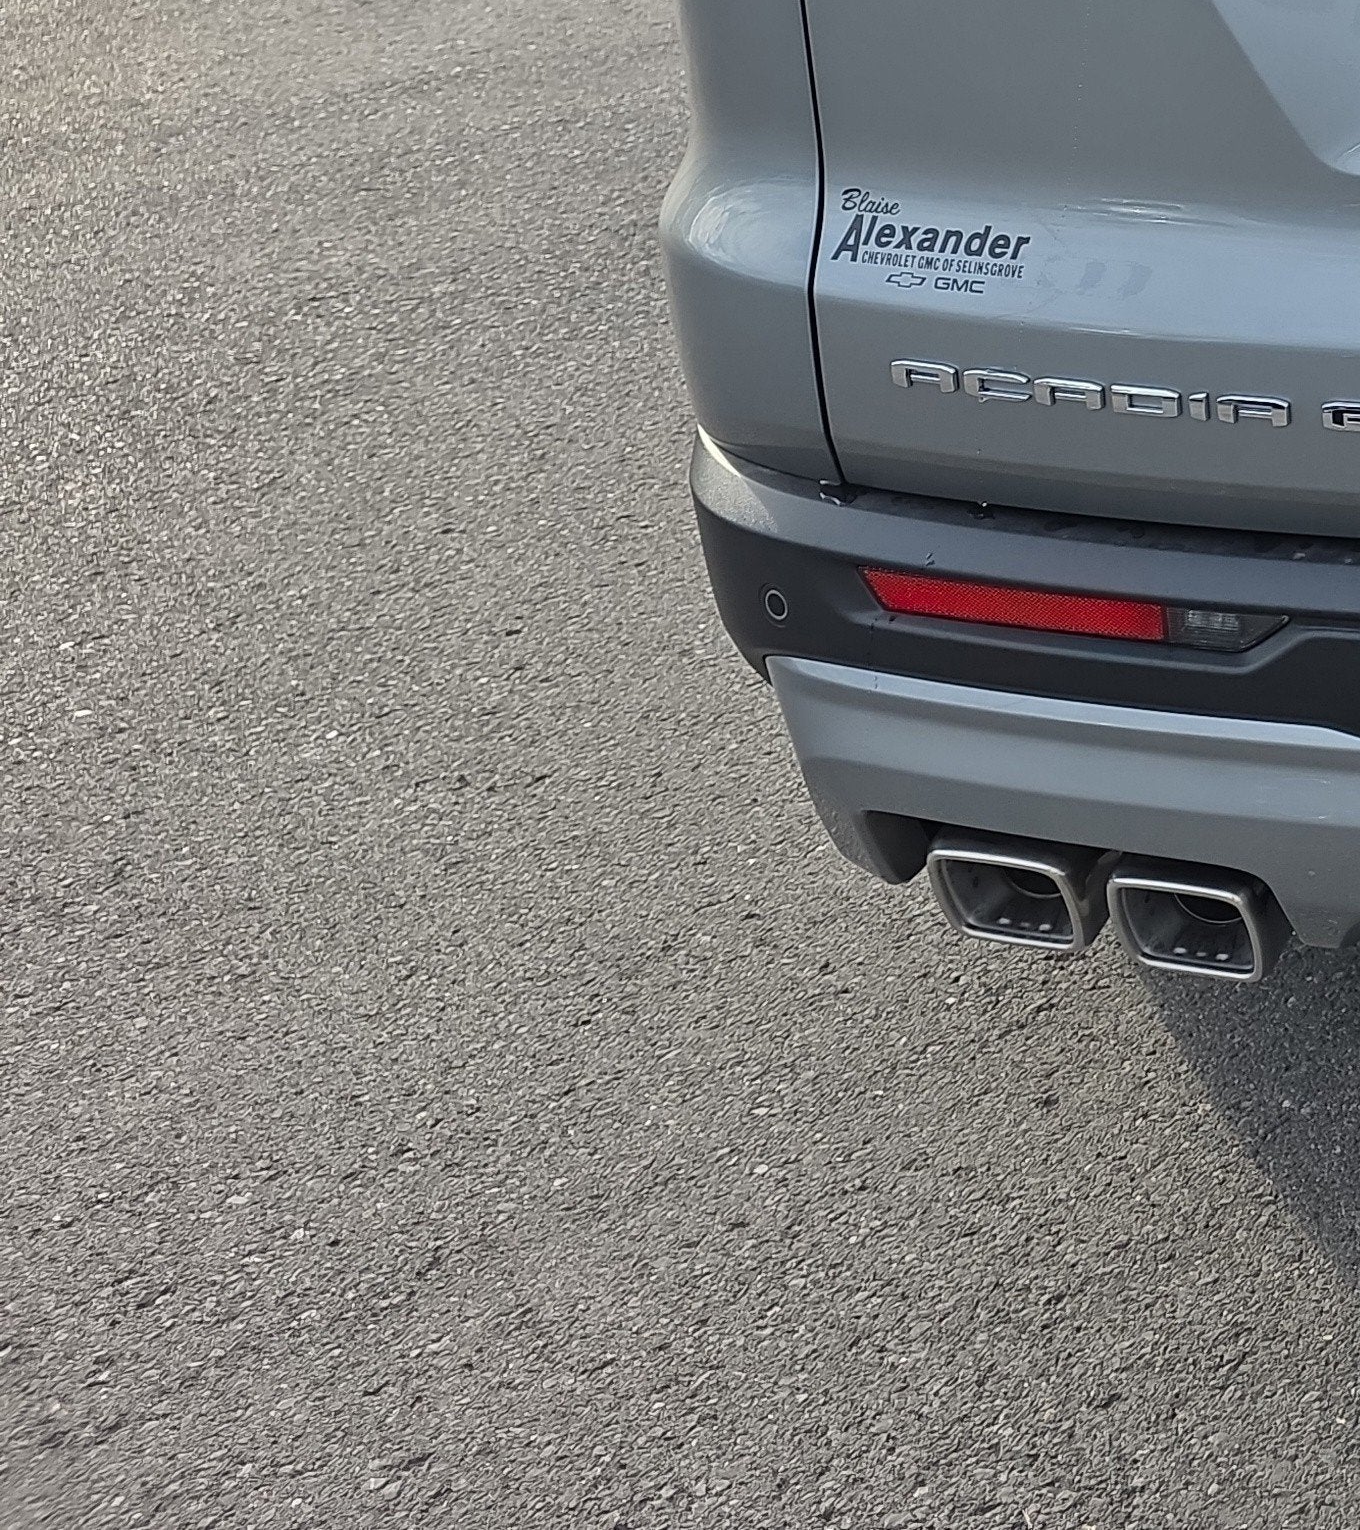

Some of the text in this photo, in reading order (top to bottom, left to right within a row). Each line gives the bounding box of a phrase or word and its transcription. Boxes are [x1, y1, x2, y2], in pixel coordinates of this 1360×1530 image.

[841, 187, 901, 216] Blaise
[830, 213, 1031, 262] Alexander
[861, 250, 1025, 279] CHEVROLET GMC OF SELINSGROVE
[933, 276, 986, 294] GMC
[890, 359, 1293, 428] ACADIA
